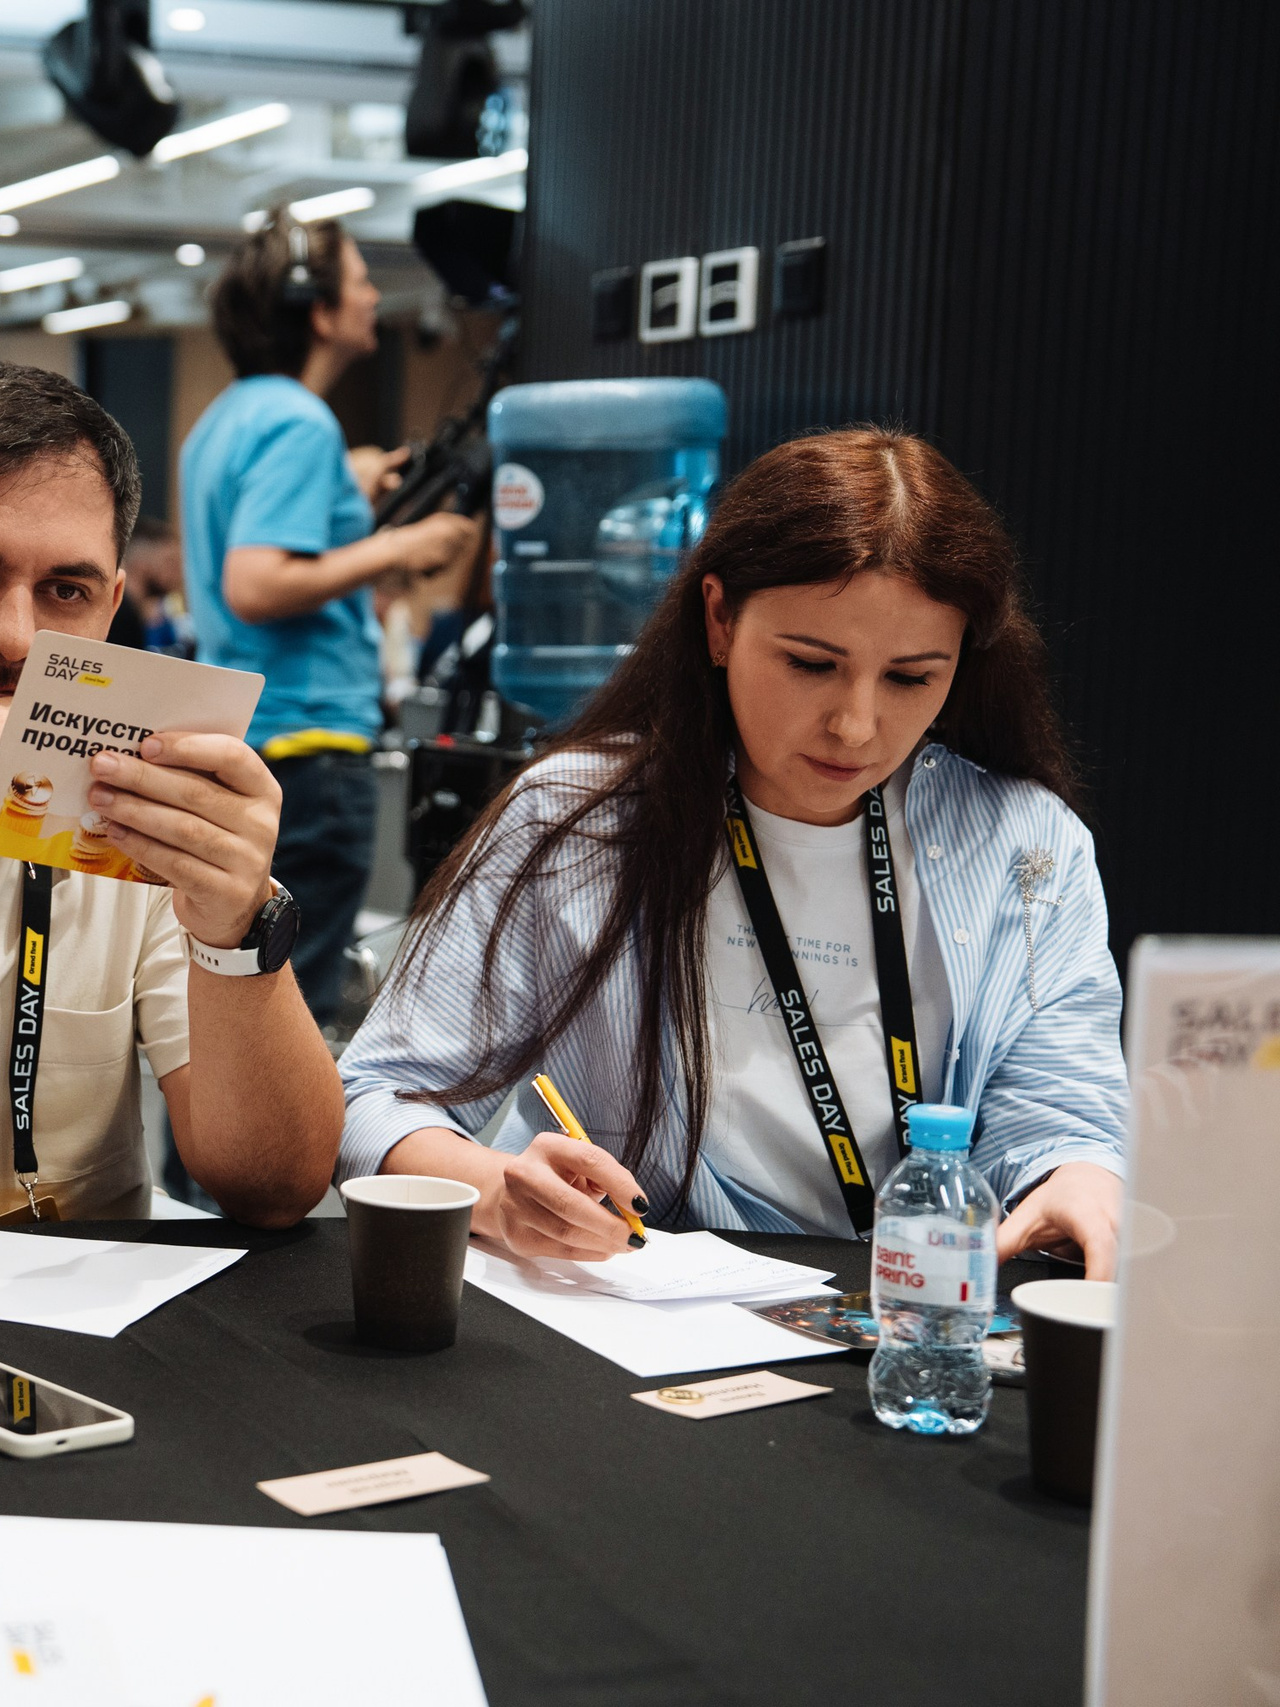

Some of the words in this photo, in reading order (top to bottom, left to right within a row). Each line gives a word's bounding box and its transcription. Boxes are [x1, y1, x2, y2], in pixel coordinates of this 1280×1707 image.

[44, 665, 79, 681] DAY
[48, 653, 103, 674] SALES
[28, 701, 157, 743] Искусств
[869, 785, 883, 817] DA
[871, 826, 896, 913] SALES
[726, 936, 757, 948] NEW
[791, 949, 839, 965] NNINGS
[846, 957, 859, 967] IS
[737, 924, 757, 936] THE
[796, 937, 822, 949] TIME
[825, 941, 851, 953] FOR
[18, 984, 40, 1035] DAY
[780, 989, 824, 1077] SALES
[812, 1083, 846, 1132] DAY
[898, 1049, 906, 1063] final
[14, 1044, 34, 1130] SALES
[838, 1142, 850, 1161] Grand
[845, 1160, 855, 1175] final
